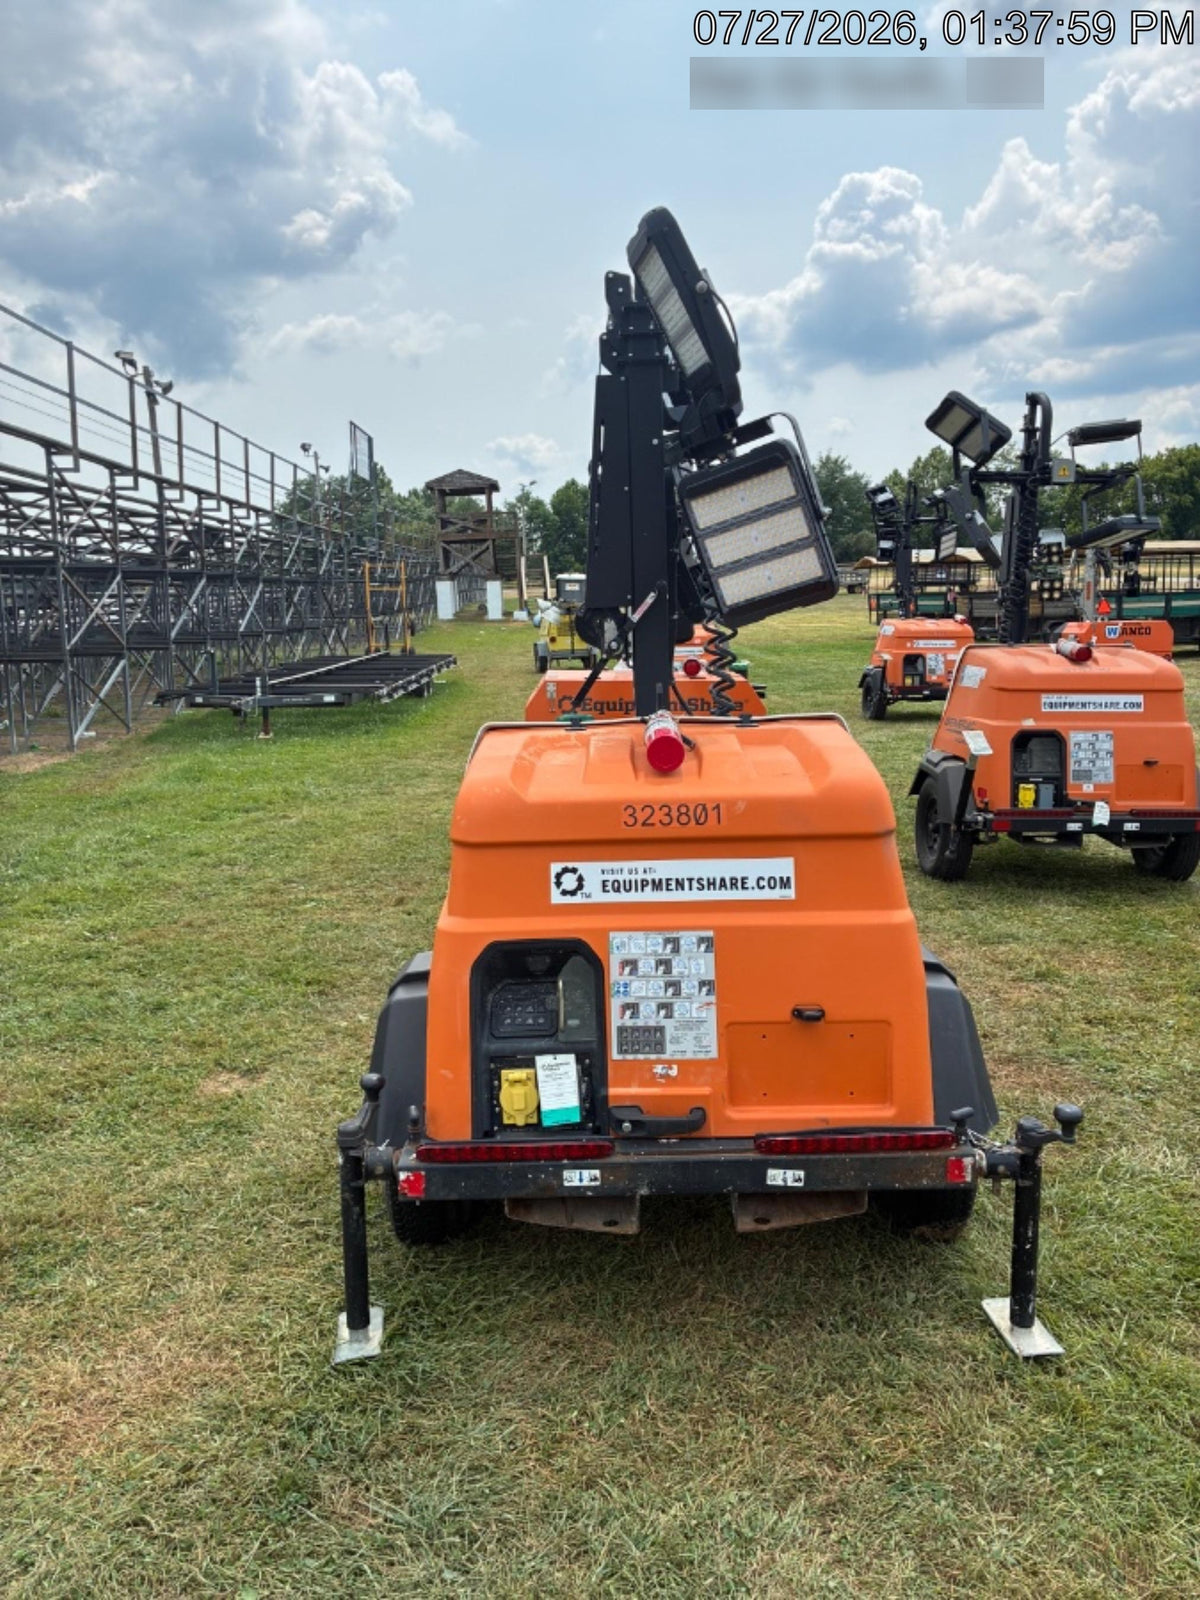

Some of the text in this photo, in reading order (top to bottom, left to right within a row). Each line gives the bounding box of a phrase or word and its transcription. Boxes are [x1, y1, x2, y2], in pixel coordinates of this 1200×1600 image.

[1104, 624, 1152, 639] WANCO
[623, 803, 722, 828] 323801
[601, 867, 624, 875] VISIT
[627, 866, 639, 875] US
[601, 876, 792, 893] EQUIPMENTSHARE.COM
